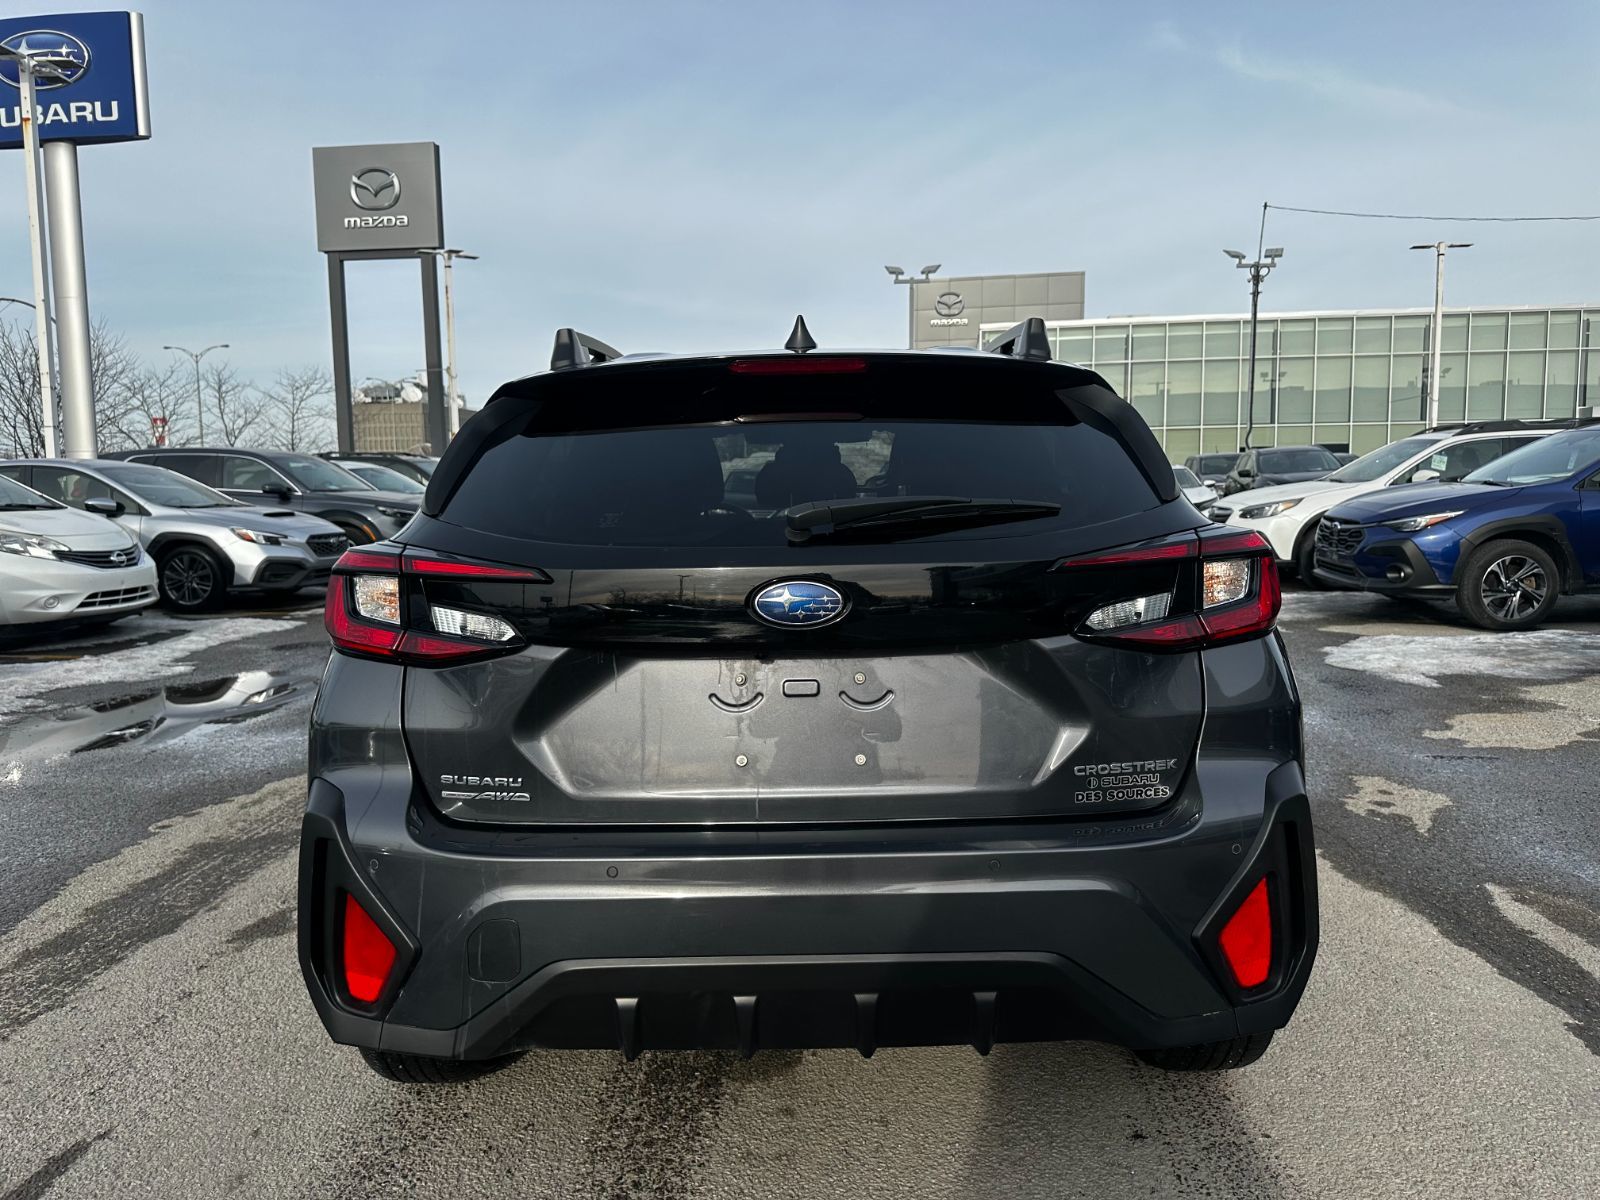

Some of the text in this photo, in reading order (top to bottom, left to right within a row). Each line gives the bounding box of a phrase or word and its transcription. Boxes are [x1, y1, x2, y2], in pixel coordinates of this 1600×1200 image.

[1073, 759, 1177, 776] CROSSTREK
[440, 774, 522, 787] SUBARU
[1100, 773, 1160, 788] SUBARU
[475, 791, 531, 802] AWD
[1075, 786, 1170, 804] DES SOURCES
